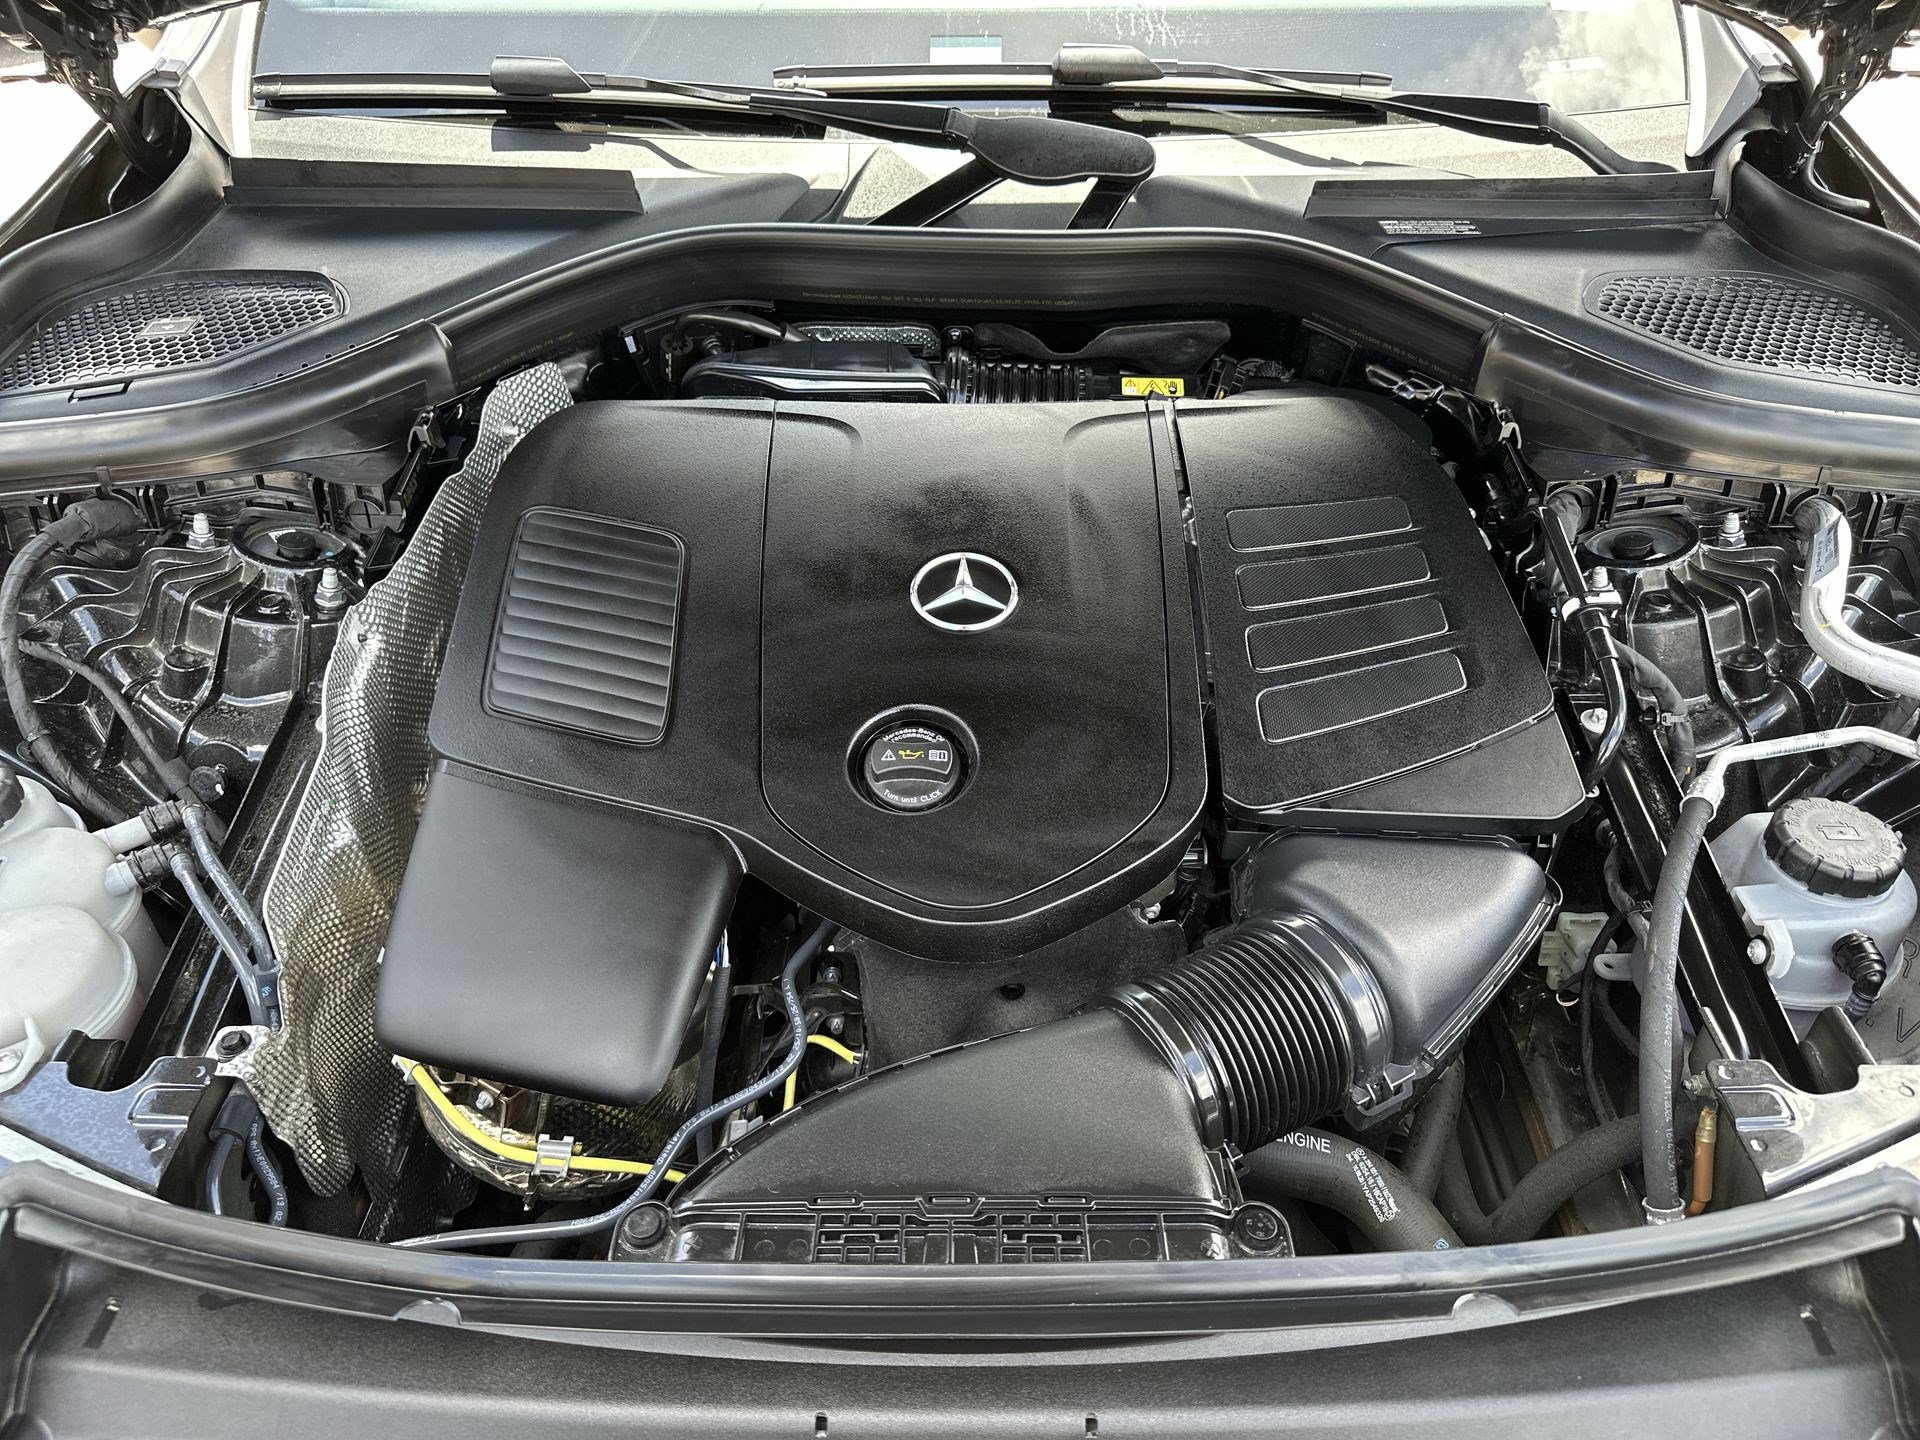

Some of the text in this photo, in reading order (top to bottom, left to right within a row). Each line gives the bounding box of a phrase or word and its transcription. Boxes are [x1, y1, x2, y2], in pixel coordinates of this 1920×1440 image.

[882, 728, 936, 742] Mercedes-Benz
[891, 733, 936, 743] recommended
[883, 788, 943, 804] Turn until CLICK
[1276, 1132, 1331, 1153] NGINE
